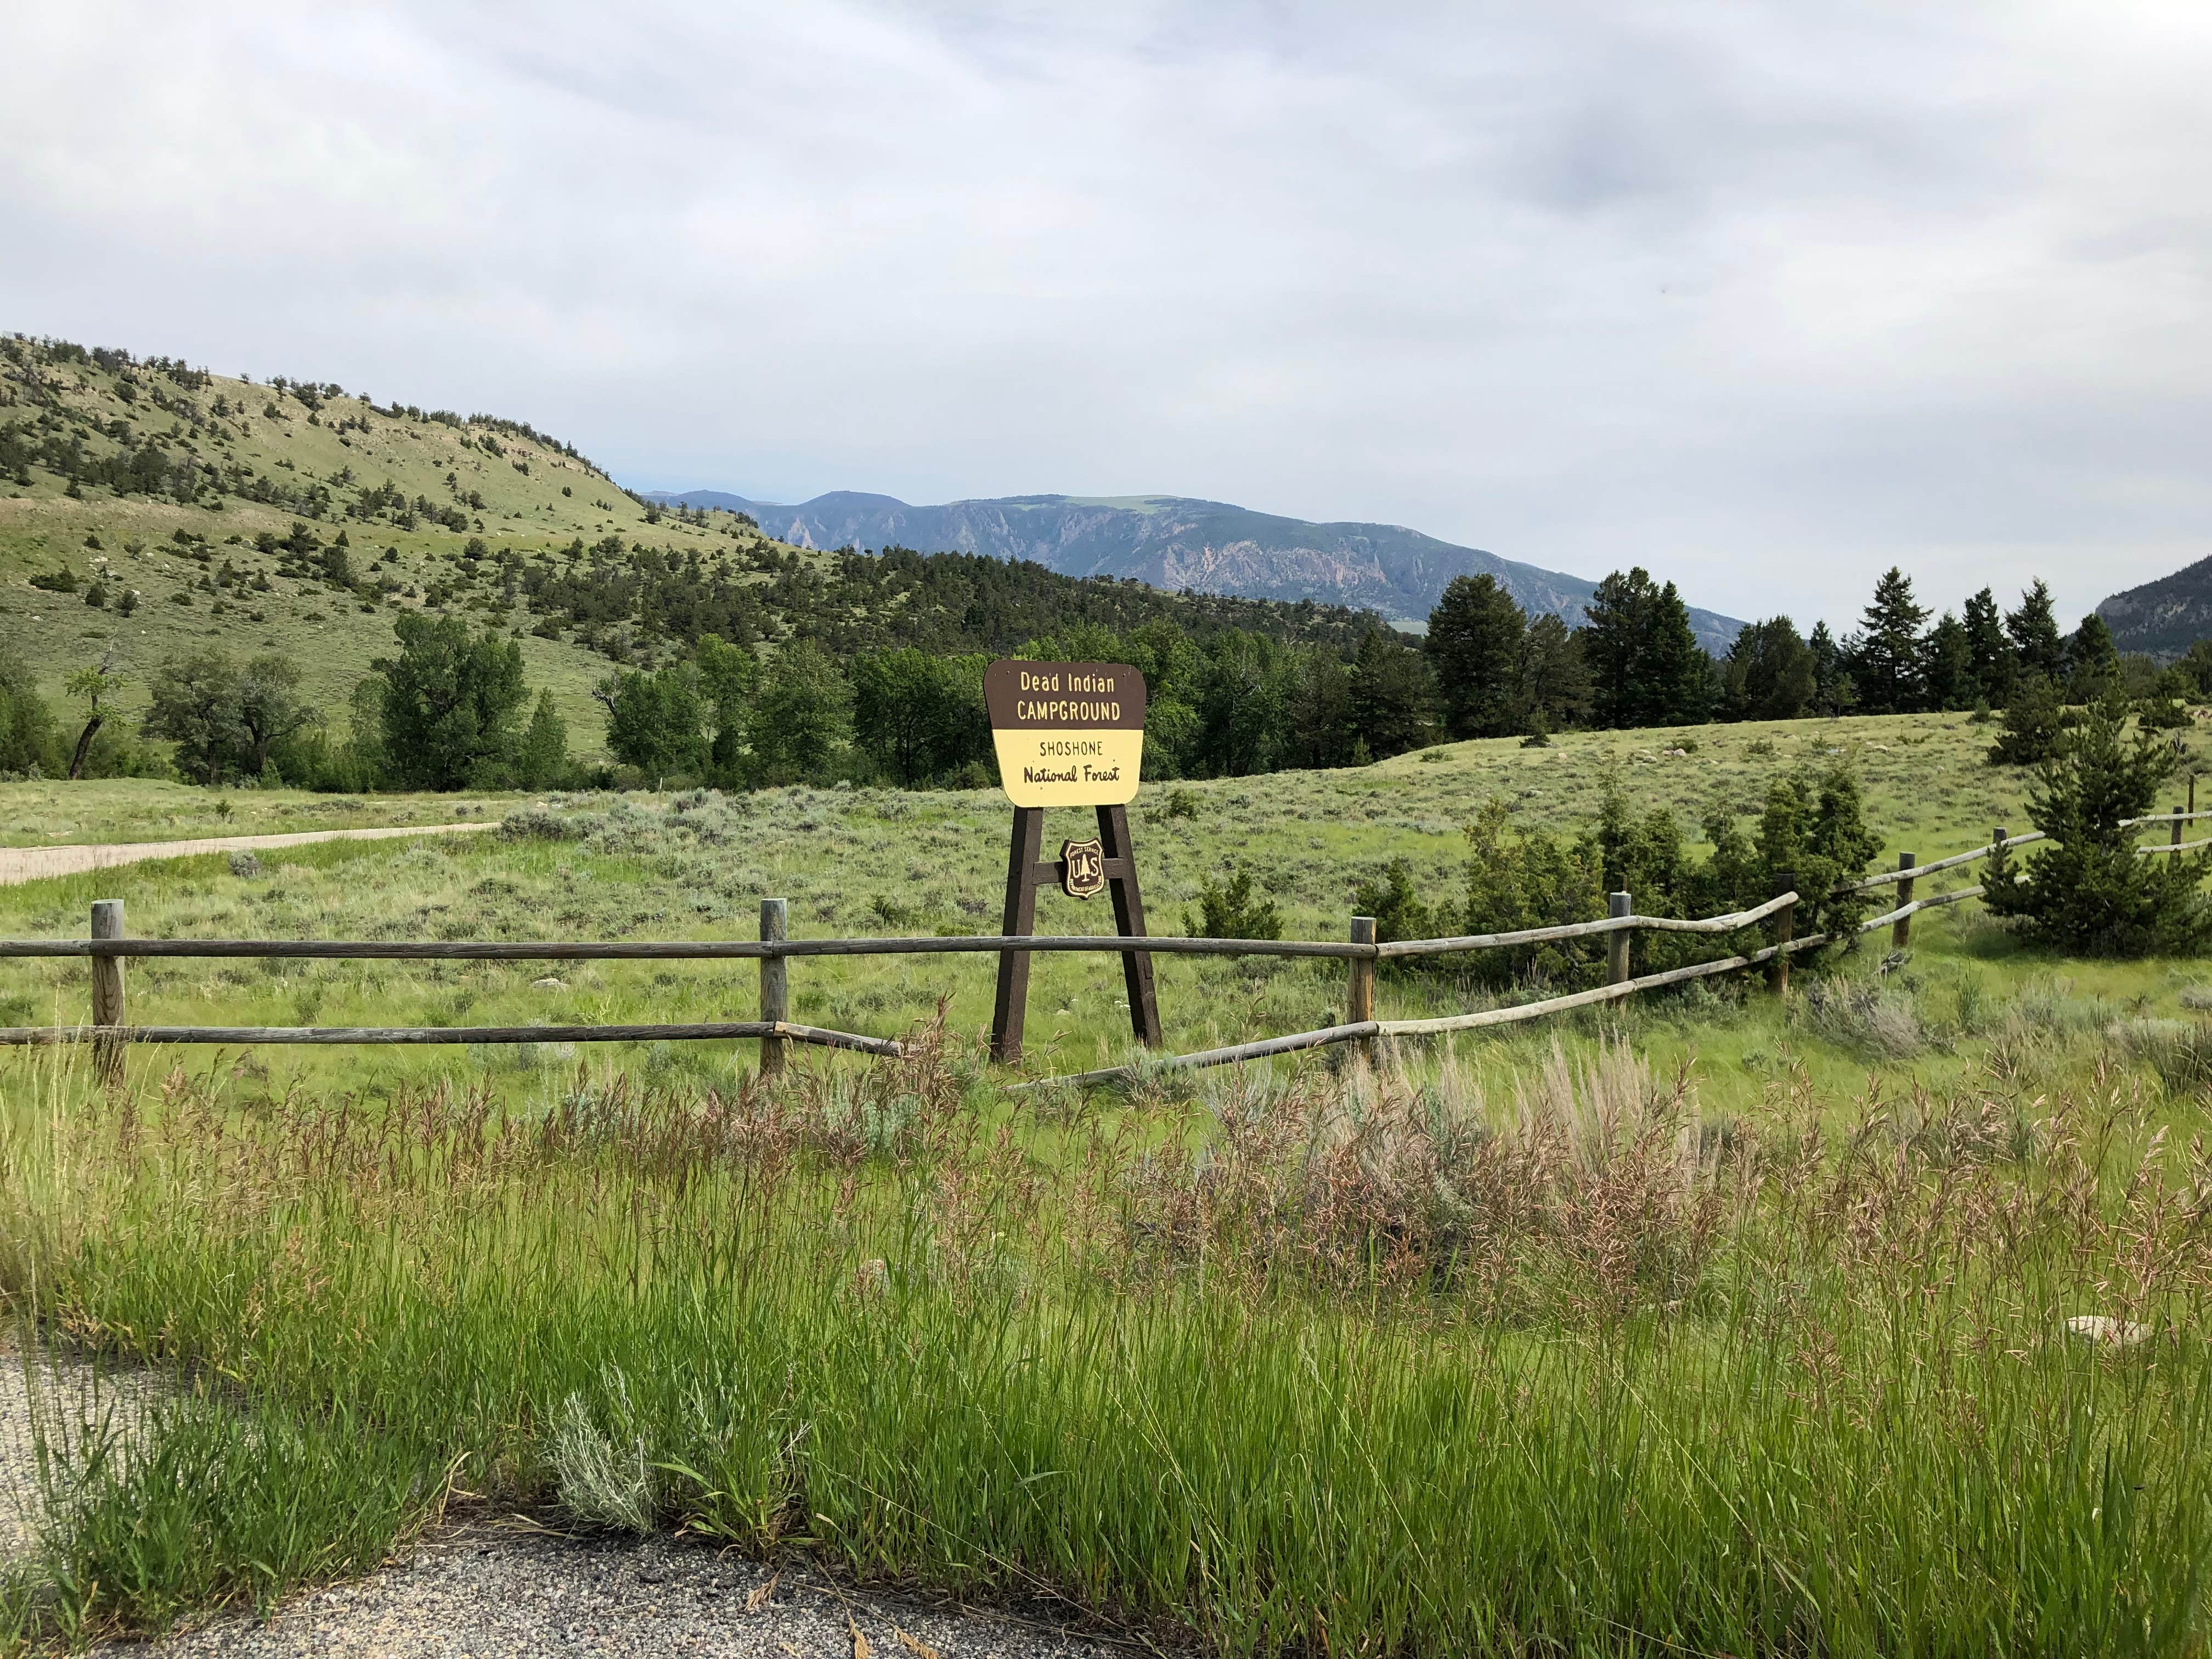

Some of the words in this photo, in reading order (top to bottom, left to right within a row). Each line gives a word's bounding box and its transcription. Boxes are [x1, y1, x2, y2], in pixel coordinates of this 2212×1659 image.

[1020, 672, 1059, 692] Dead
[1068, 673, 1115, 693] Indian
[1017, 700, 1120, 721] CAMPGROUND
[1040, 741, 1103, 756] SHOSHONE
[1024, 765, 1077, 783] National
[1083, 764, 1120, 782] Forest
[1070, 847, 1083, 858] FOREST
